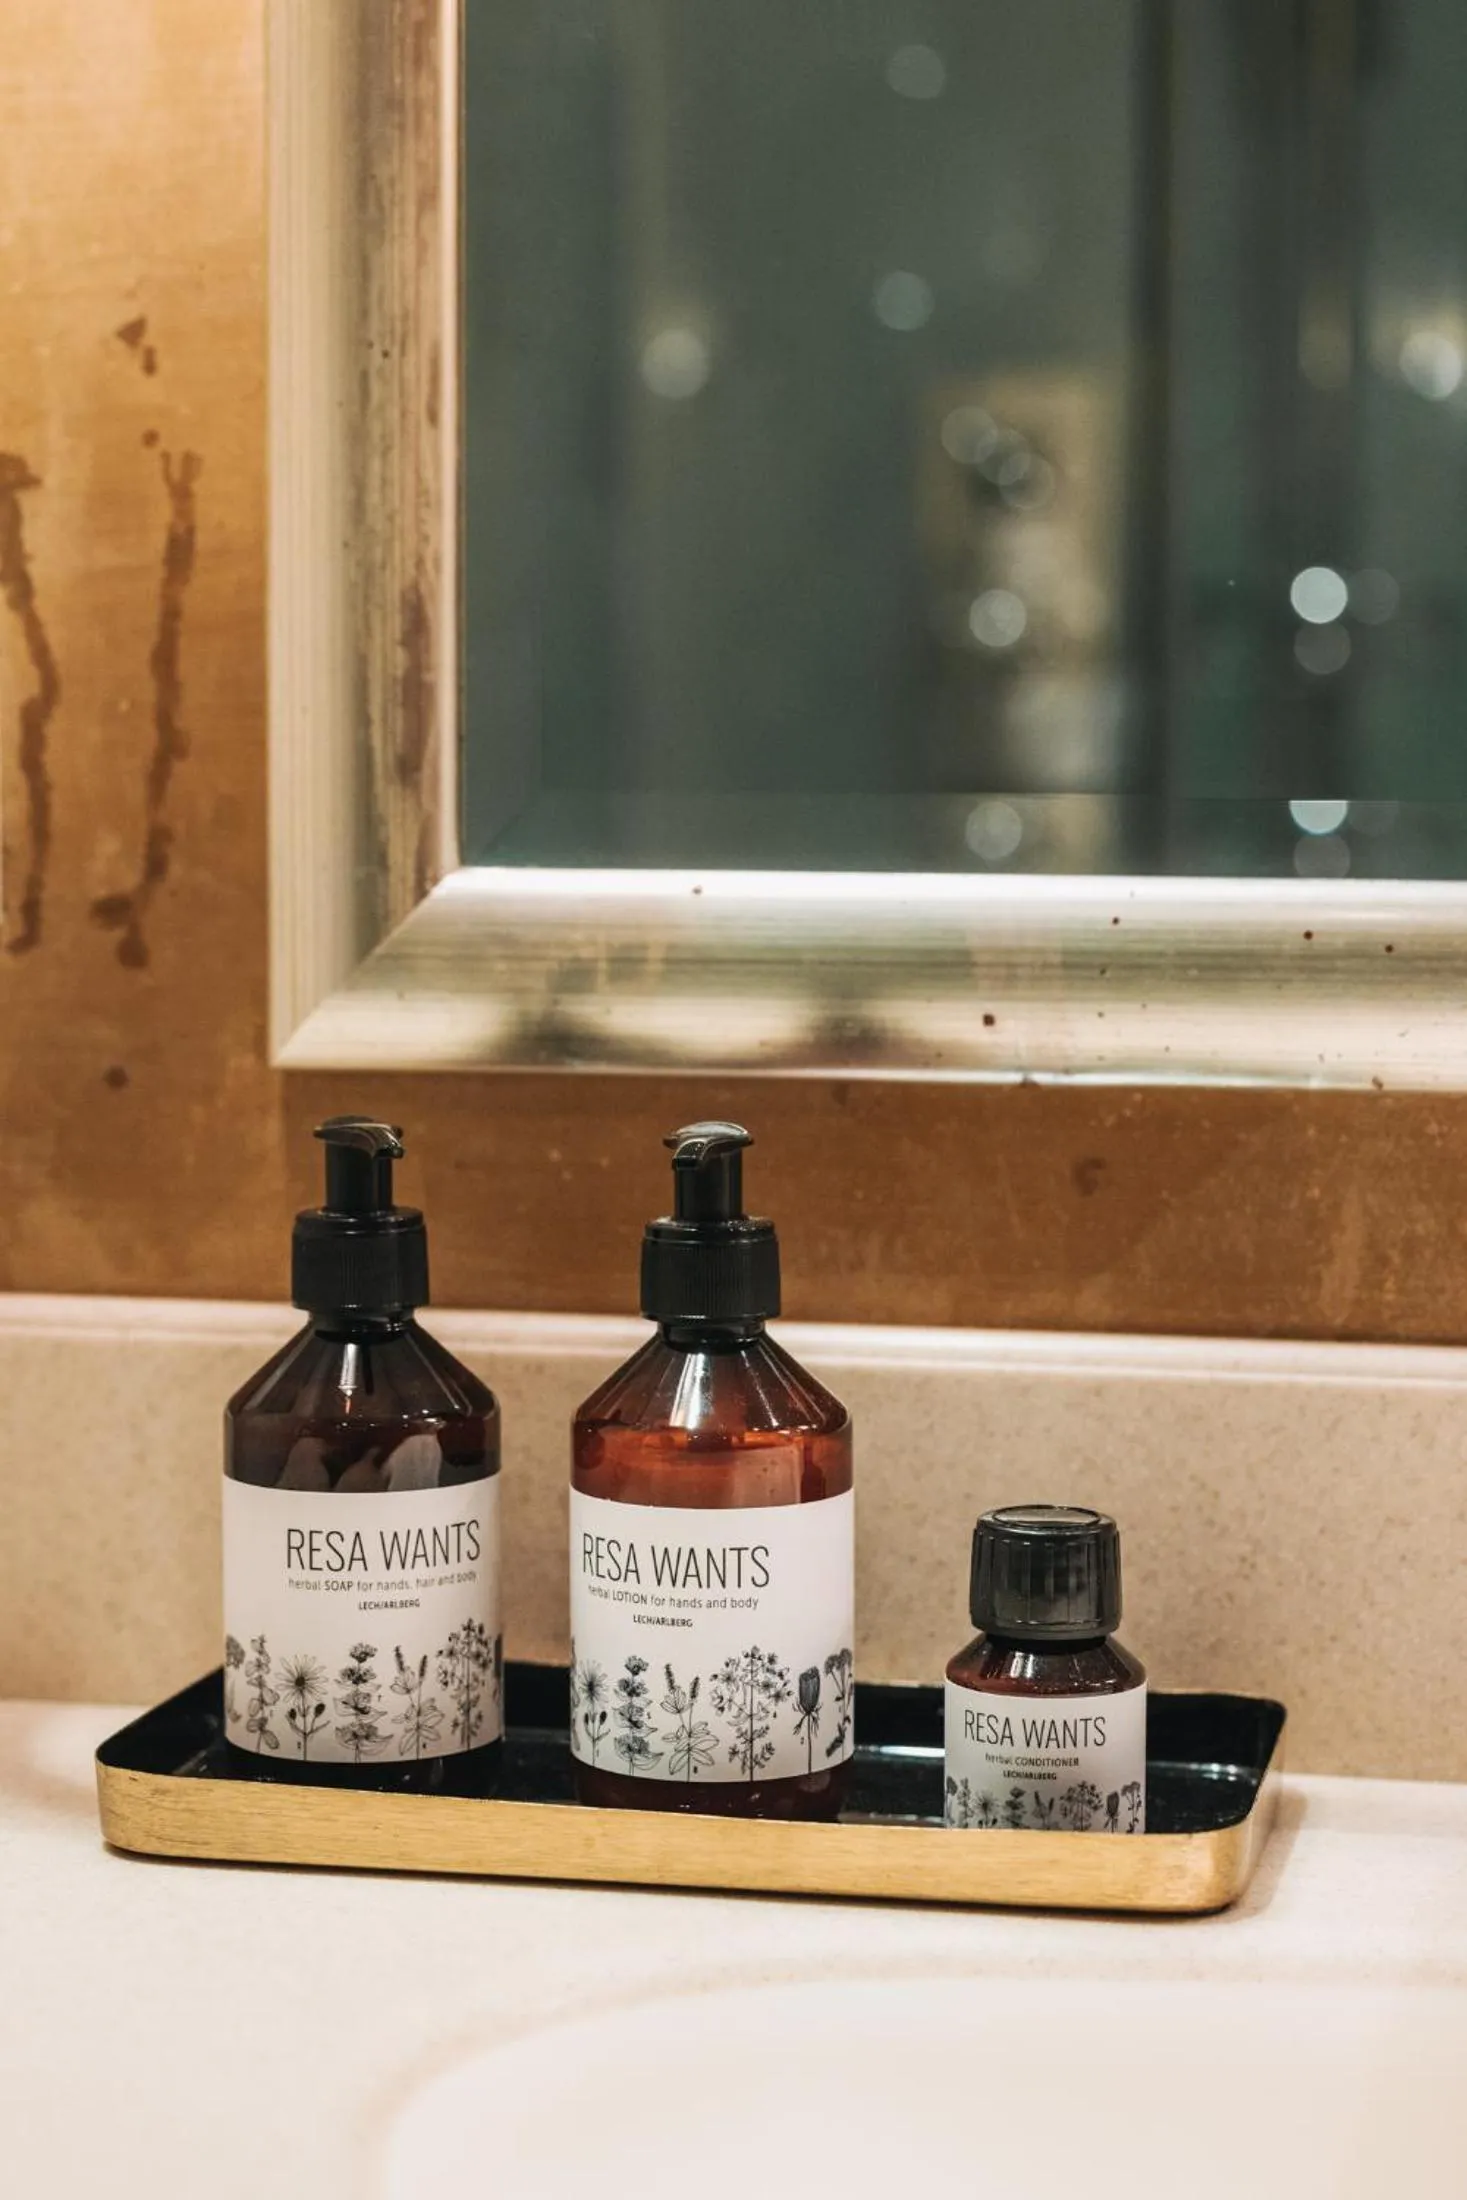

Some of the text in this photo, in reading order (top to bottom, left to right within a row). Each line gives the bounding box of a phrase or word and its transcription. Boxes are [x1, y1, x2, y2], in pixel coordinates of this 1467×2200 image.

[287, 1519, 481, 1572] RESA WANTS
[583, 1532, 770, 1589] RESA WANTS
[288, 1577, 321, 1592] herbal
[324, 1580, 353, 1592] SOAP
[357, 1579, 373, 1592] for
[437, 1572, 455, 1586] and
[612, 1589, 648, 1605] LOTION
[650, 1594, 666, 1607] for
[669, 1596, 703, 1609] hands
[706, 1597, 727, 1609] and
[730, 1597, 759, 1611] body
[633, 1613, 693, 1628] LECH/ARLBERG
[964, 1708, 1106, 1749] RESA WANTS
[1014, 1755, 1080, 1767] CONDITIONER
